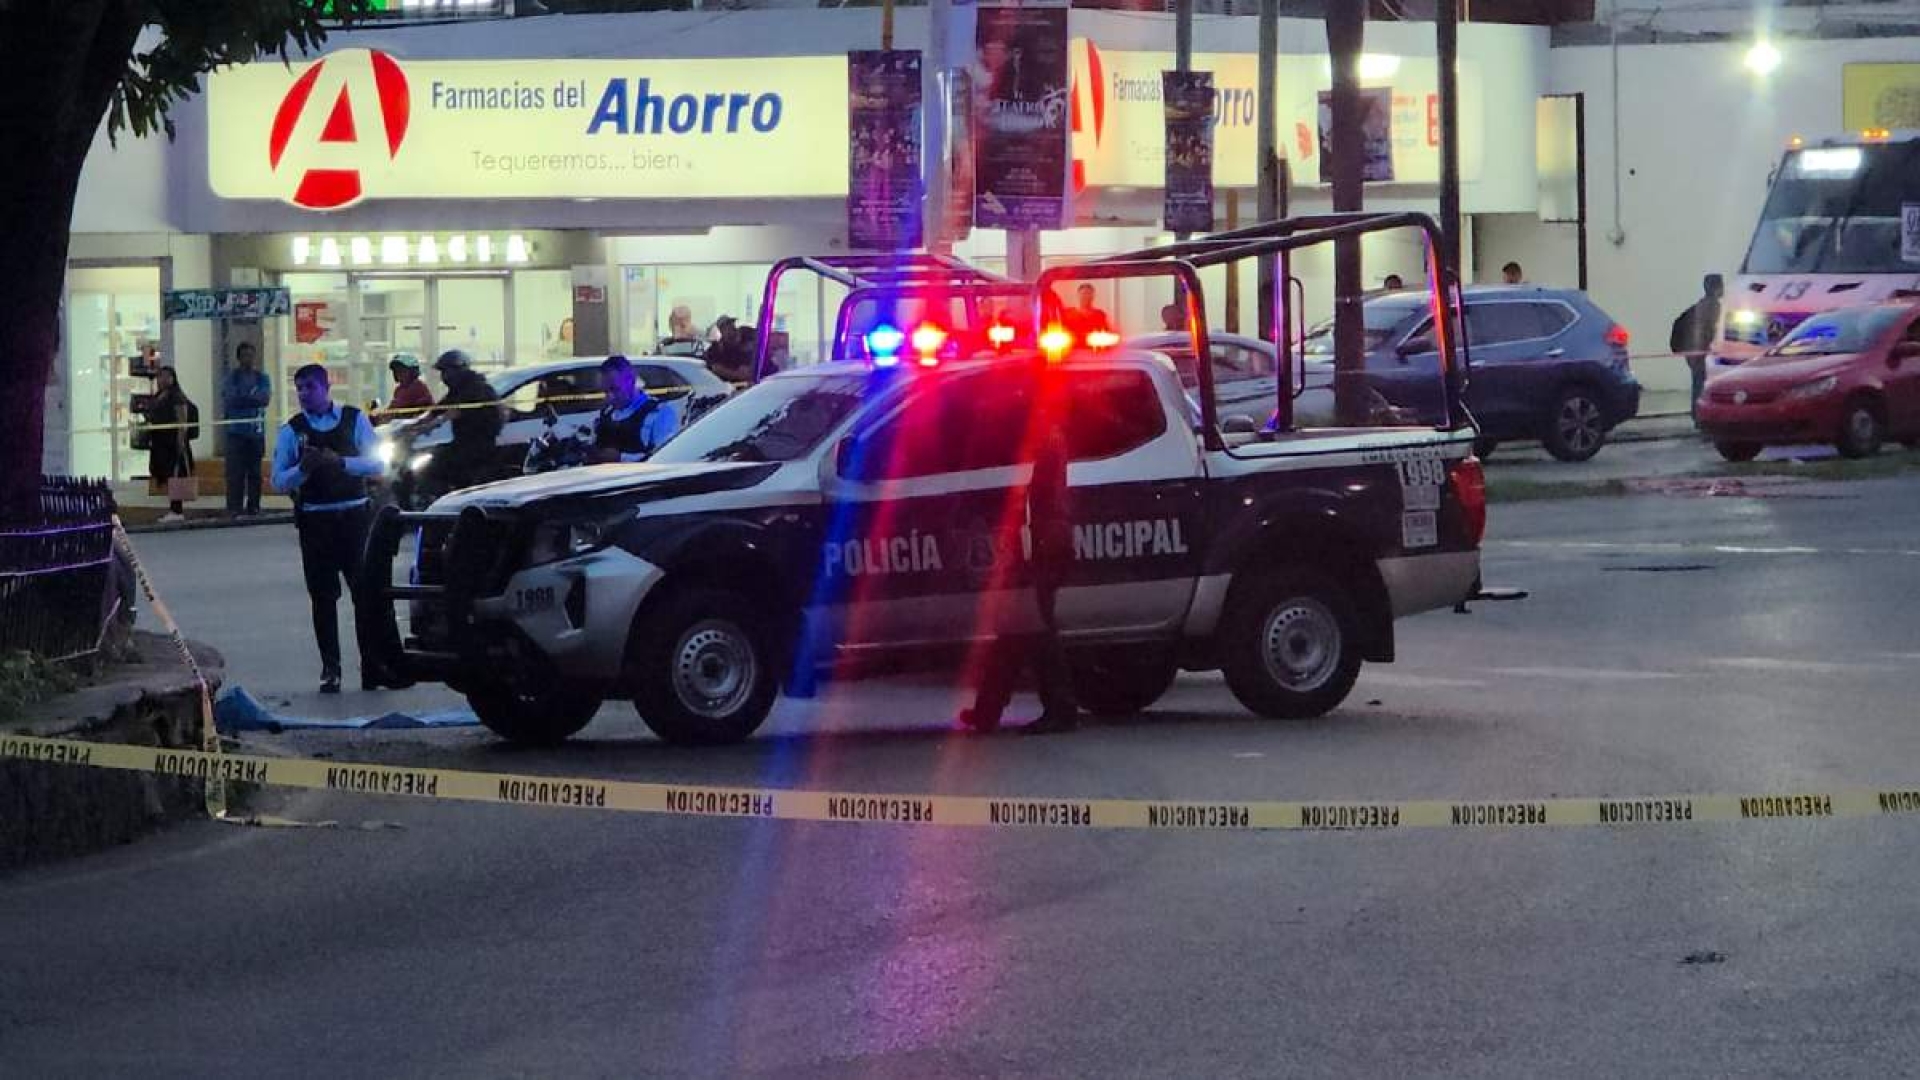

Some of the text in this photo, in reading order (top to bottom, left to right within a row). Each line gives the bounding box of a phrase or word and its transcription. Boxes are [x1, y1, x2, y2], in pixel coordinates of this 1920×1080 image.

[432, 77, 783, 135] Farmacias del Ahorro
[1213, 88, 1255, 126] orro
[632, 149, 679, 170] bien
[292, 234, 530, 266] FARMACIA
[824, 518, 1189, 577] POLICÍA NICIPAL
[155, 753, 268, 782] PRECAUCION
[327, 767, 439, 795] PRECAUCION
[500, 779, 606, 807] PRECAUCION
[666, 789, 774, 816] PRECAUCION
[828, 797, 934, 822] PRECAUCION
[989, 801, 1091, 826] PRECAUCION
[1451, 804, 1547, 825] PRECAUCION
[1599, 801, 1693, 823] PRECAUCION
[1740, 793, 1833, 818] PRECAUCION
[1149, 805, 1249, 827] PRECAUCION
[1301, 805, 1400, 827] PRECAUCION
